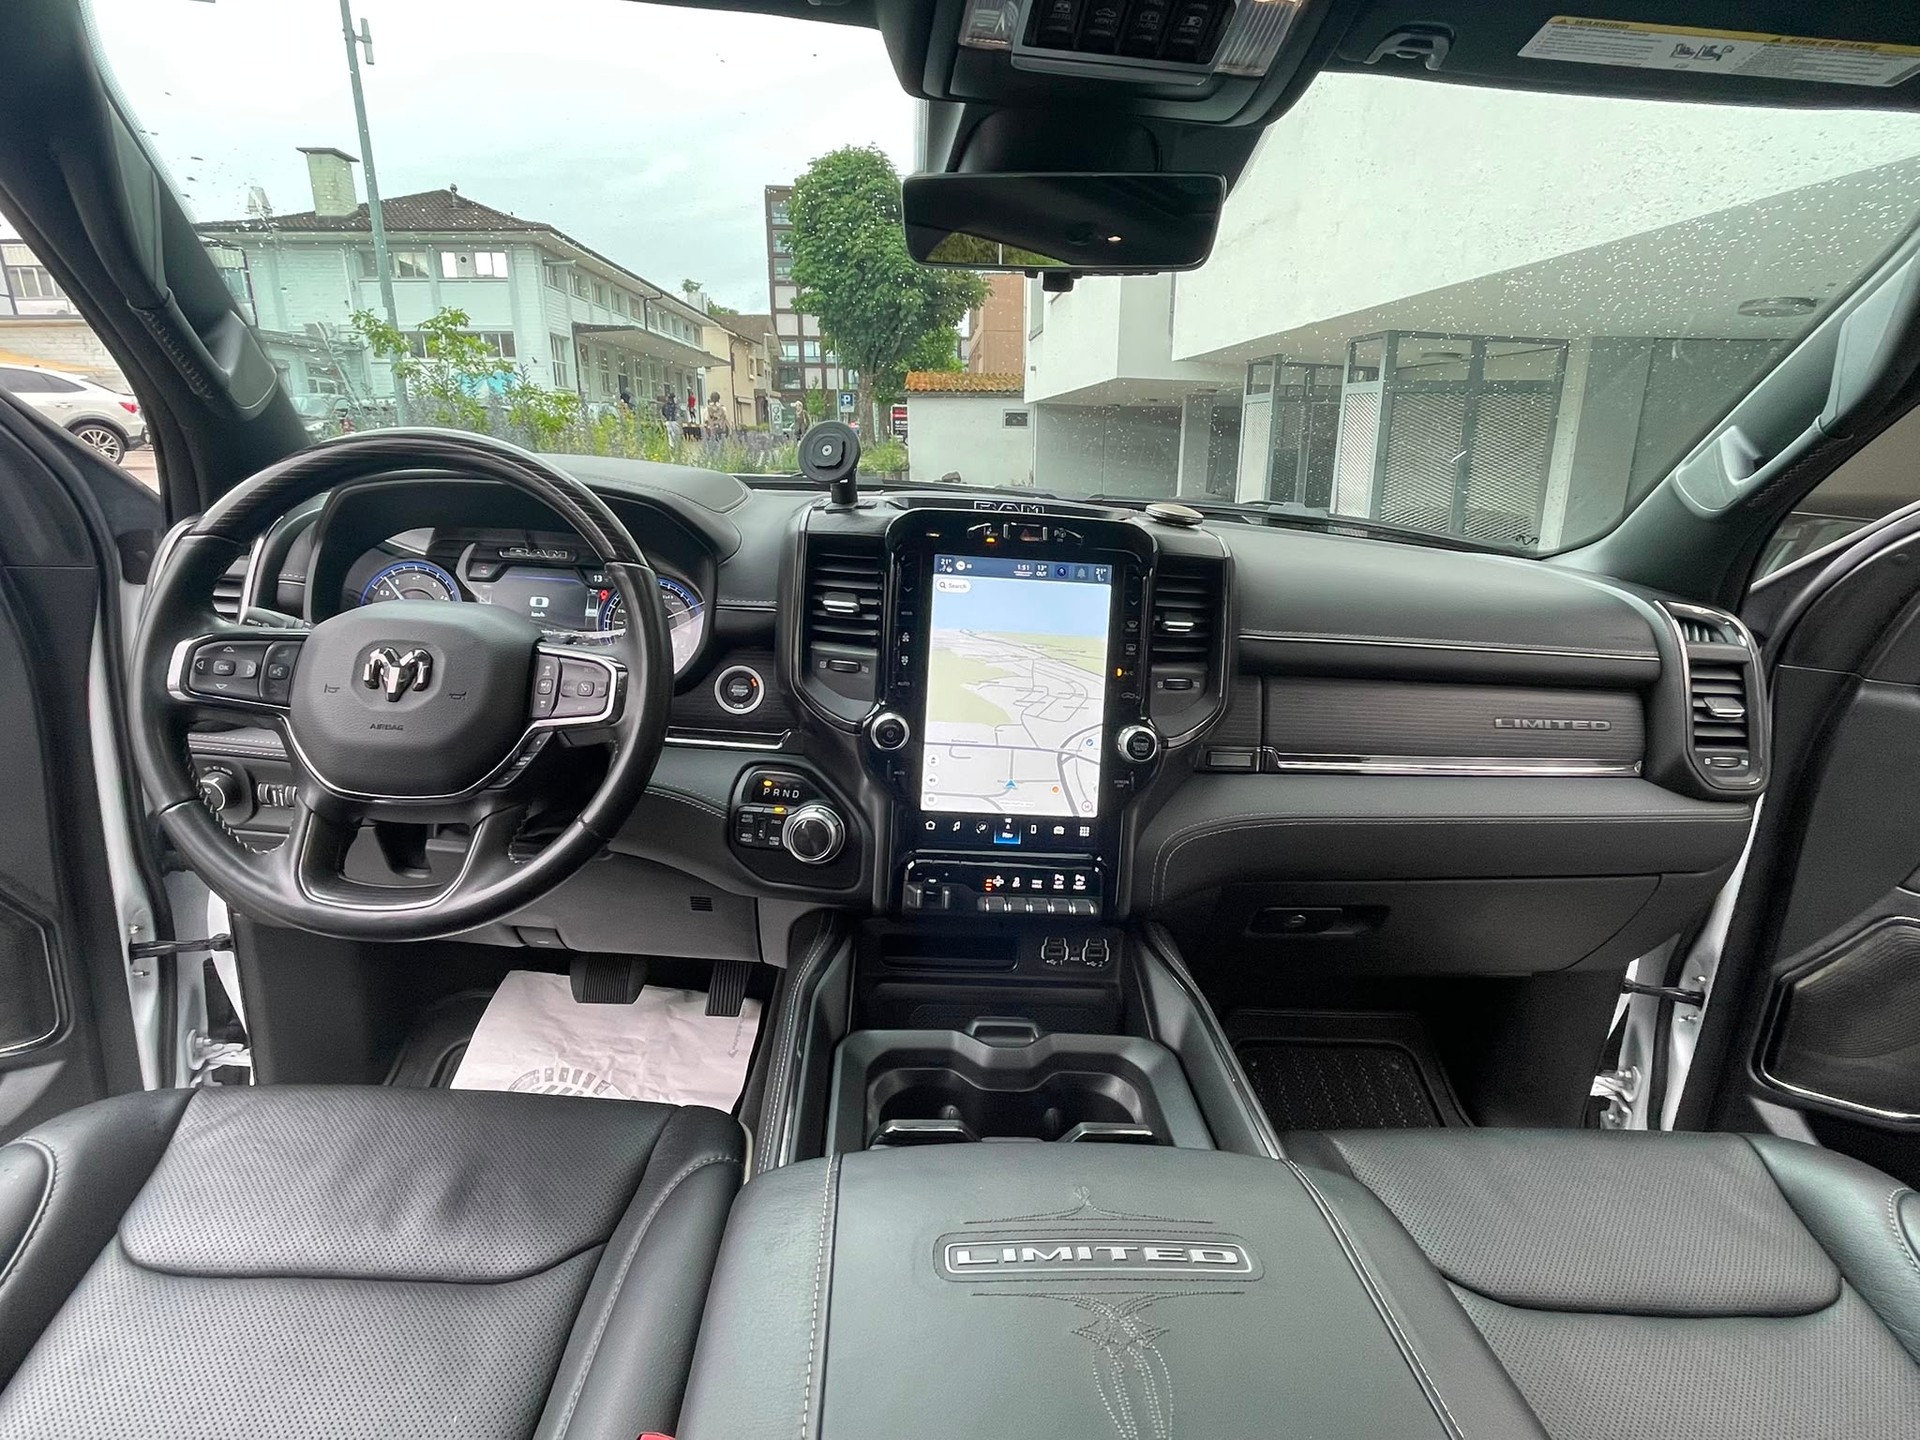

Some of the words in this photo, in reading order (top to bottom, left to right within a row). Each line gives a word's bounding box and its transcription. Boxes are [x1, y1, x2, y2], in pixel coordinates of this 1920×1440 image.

[1574, 19, 1630, 29] WARNING
[842, 394, 851, 405] P
[974, 500, 1045, 513] RAM
[509, 547, 568, 559] RAM
[369, 723, 404, 731] AIRBAG
[1495, 718, 1611, 731] LIMITED
[956, 1246, 1239, 1265] LIMITED
